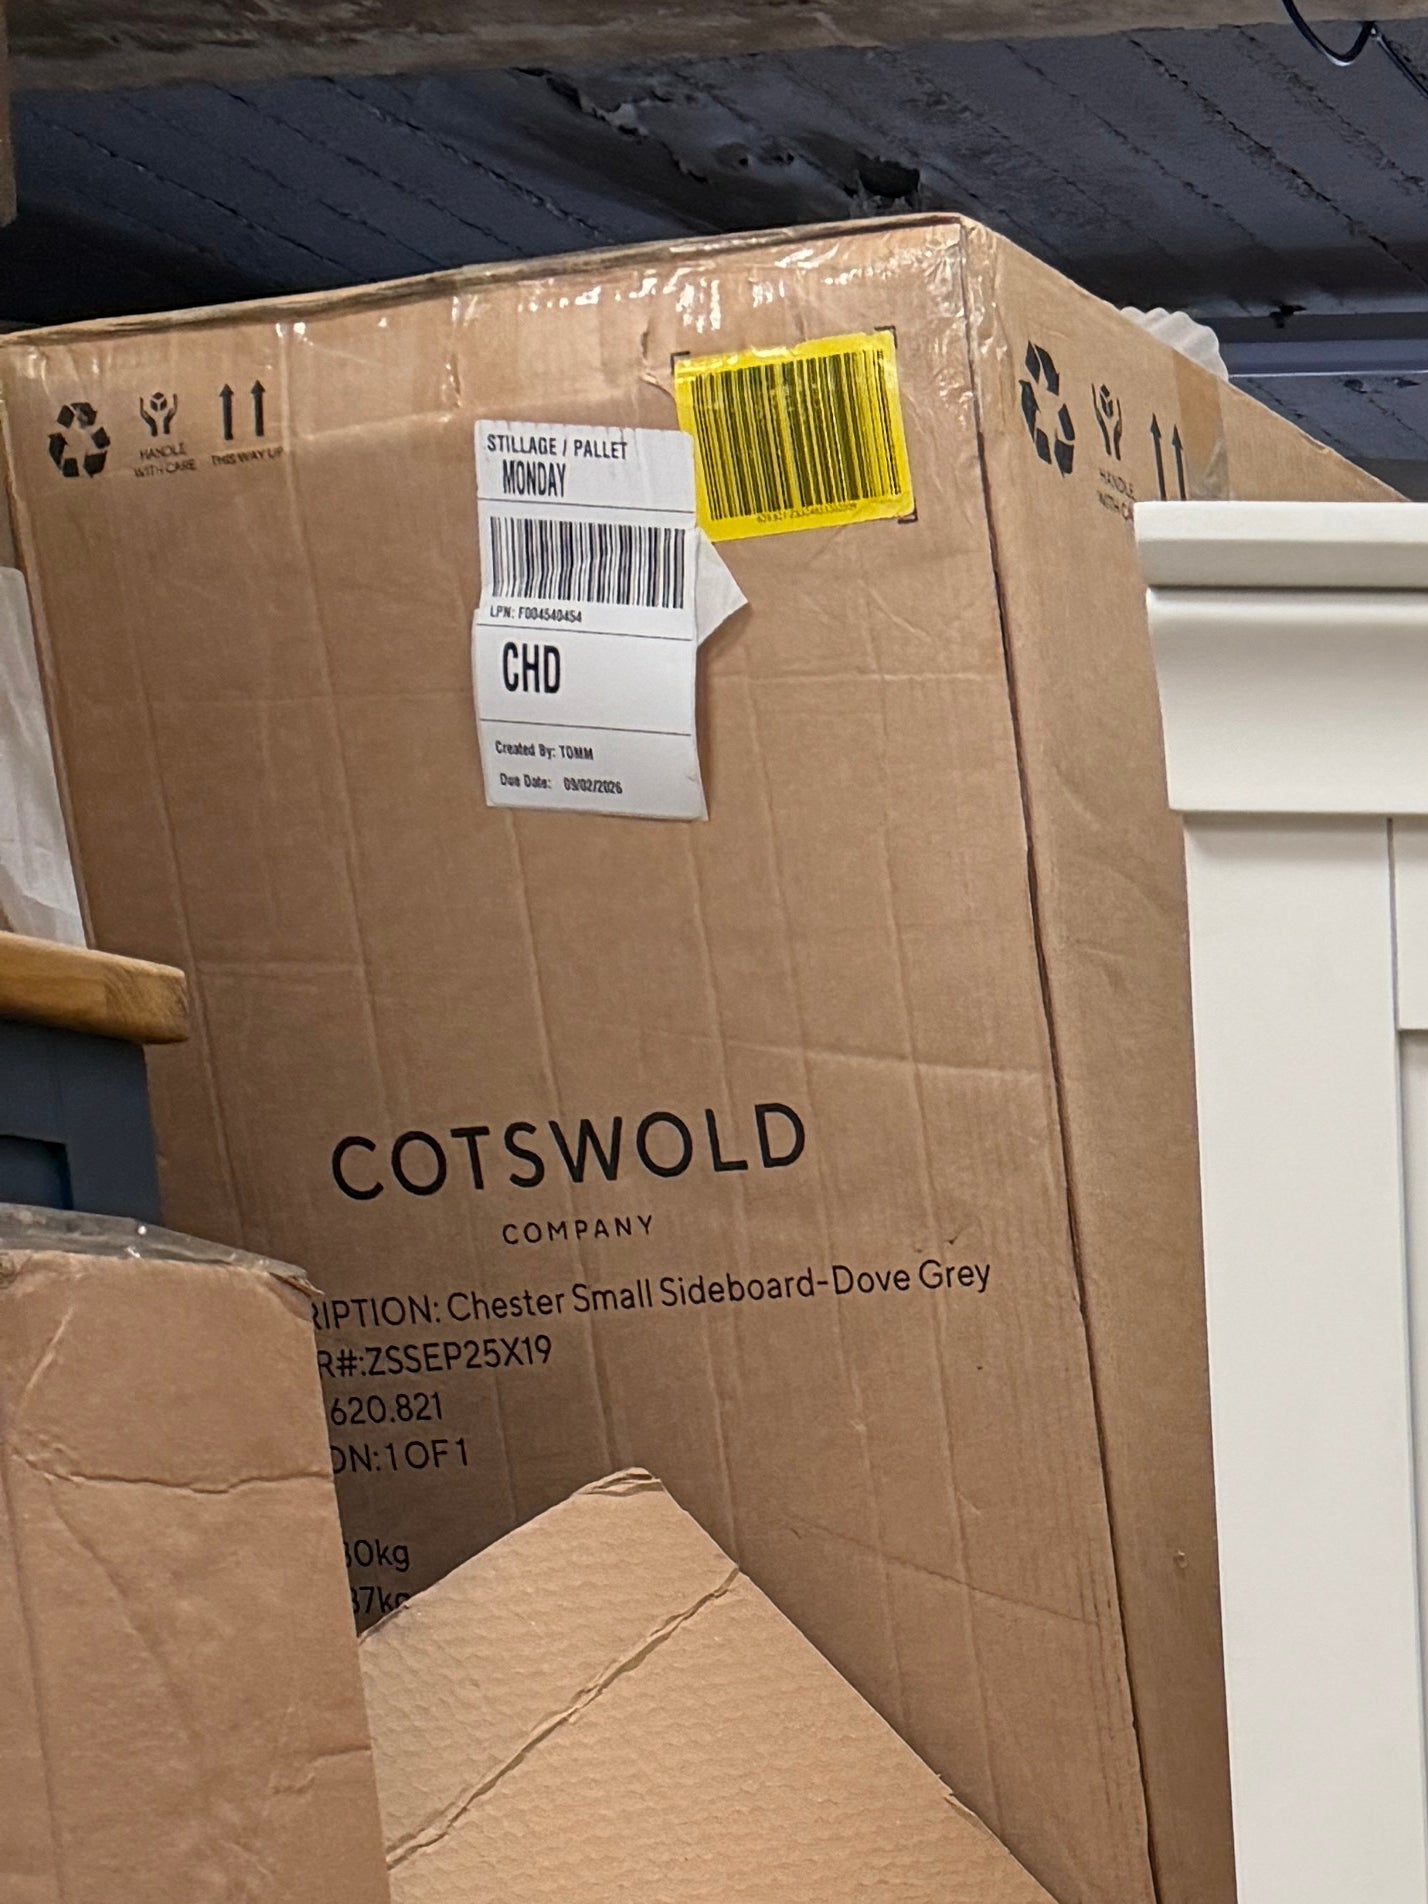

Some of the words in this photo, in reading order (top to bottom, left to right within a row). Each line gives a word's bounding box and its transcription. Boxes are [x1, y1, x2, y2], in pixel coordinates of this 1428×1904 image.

[487, 434, 557, 456] STILLAGE
[562, 440, 568, 456] /
[573, 440, 628, 459] PALLET
[503, 460, 566, 497] MONDAY
[490, 605, 515, 619] LPN:
[503, 642, 561, 693] CHD
[495, 740, 536, 757] Created
[539, 743, 556, 758] By:
[559, 745, 594, 760] TOMM
[500, 773, 520, 787] Due
[524, 774, 551, 789] Date:
[331, 1102, 806, 1201] COTSWOLD
[502, 1215, 652, 1244] COMPANY
[447, 1291, 565, 1322] Chester
[572, 1279, 653, 1312] Small
[659, 1265, 910, 1307] Sideboard-Dove
[918, 1259, 990, 1293] Grey
[330, 1391, 443, 1426] 620.821
